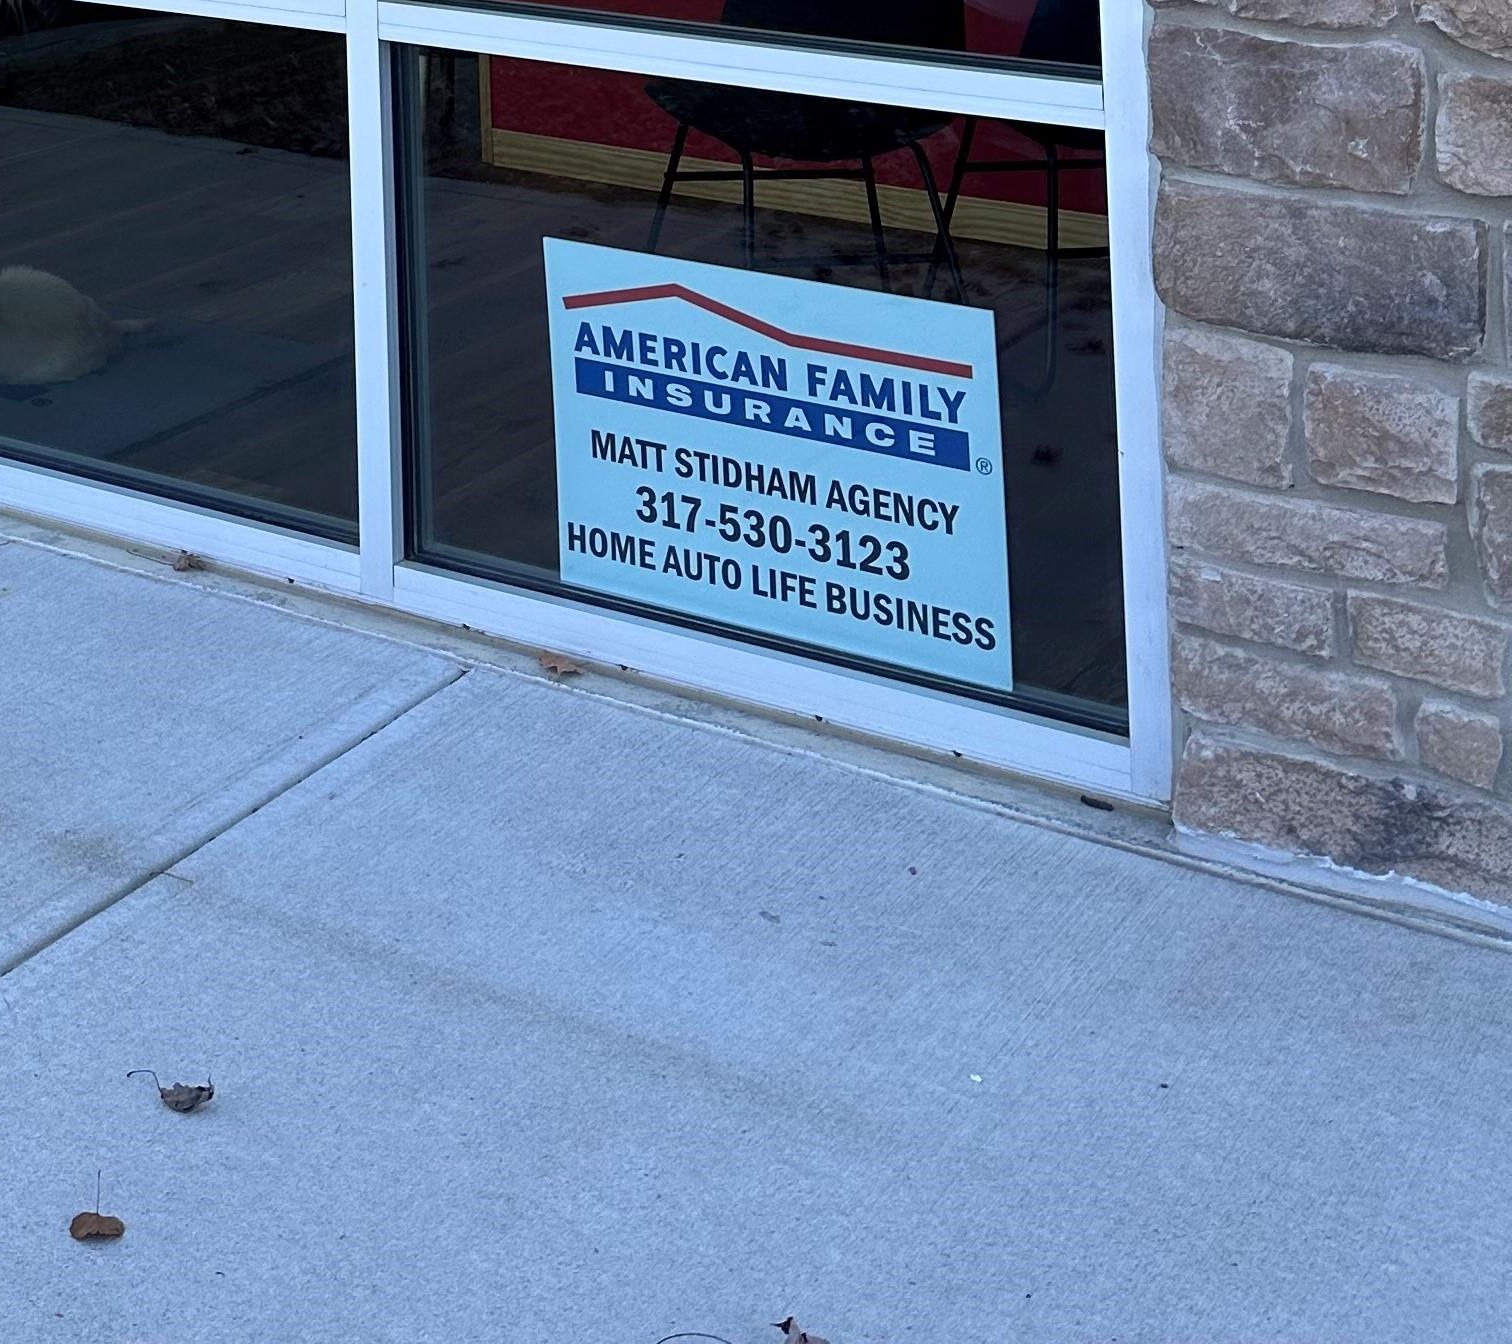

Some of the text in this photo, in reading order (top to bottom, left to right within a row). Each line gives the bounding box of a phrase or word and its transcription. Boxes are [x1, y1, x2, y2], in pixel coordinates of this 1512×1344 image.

[574, 321, 967, 425] AMERICAN FAMILY
[603, 370, 936, 456] INSURANCE
[590, 429, 960, 536] MATT STIDHAM AGENCY
[635, 486, 911, 580] 317-530-3123
[567, 522, 997, 650] HOME AUTO LIFE BUSINESS
